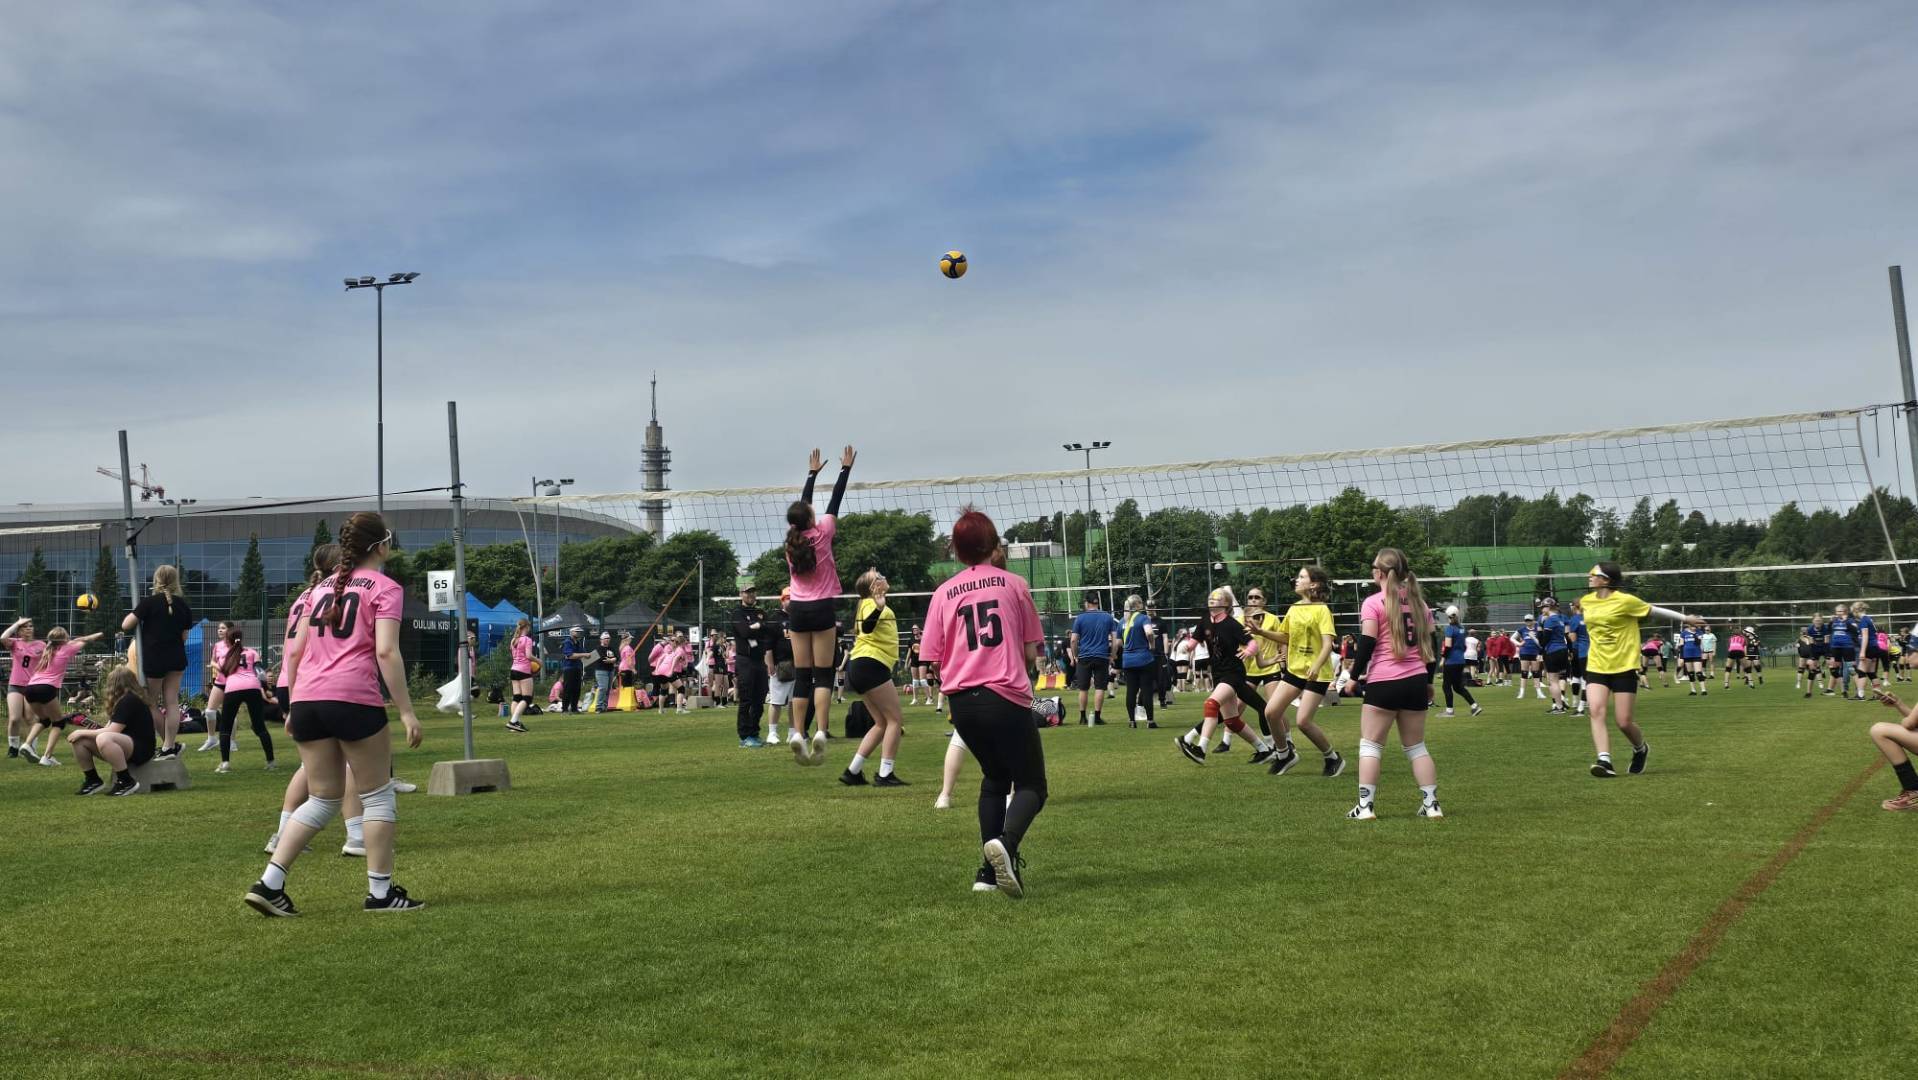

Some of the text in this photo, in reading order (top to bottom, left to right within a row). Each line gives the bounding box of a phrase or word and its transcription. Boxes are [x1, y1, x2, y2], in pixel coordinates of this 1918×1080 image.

[433, 579, 448, 589] 65
[946, 576, 1006, 600] HAKULINEN
[309, 591, 360, 639] 40
[412, 618, 437, 631] OULUN
[957, 599, 1004, 652] 15
[22, 655, 31, 669] 8
